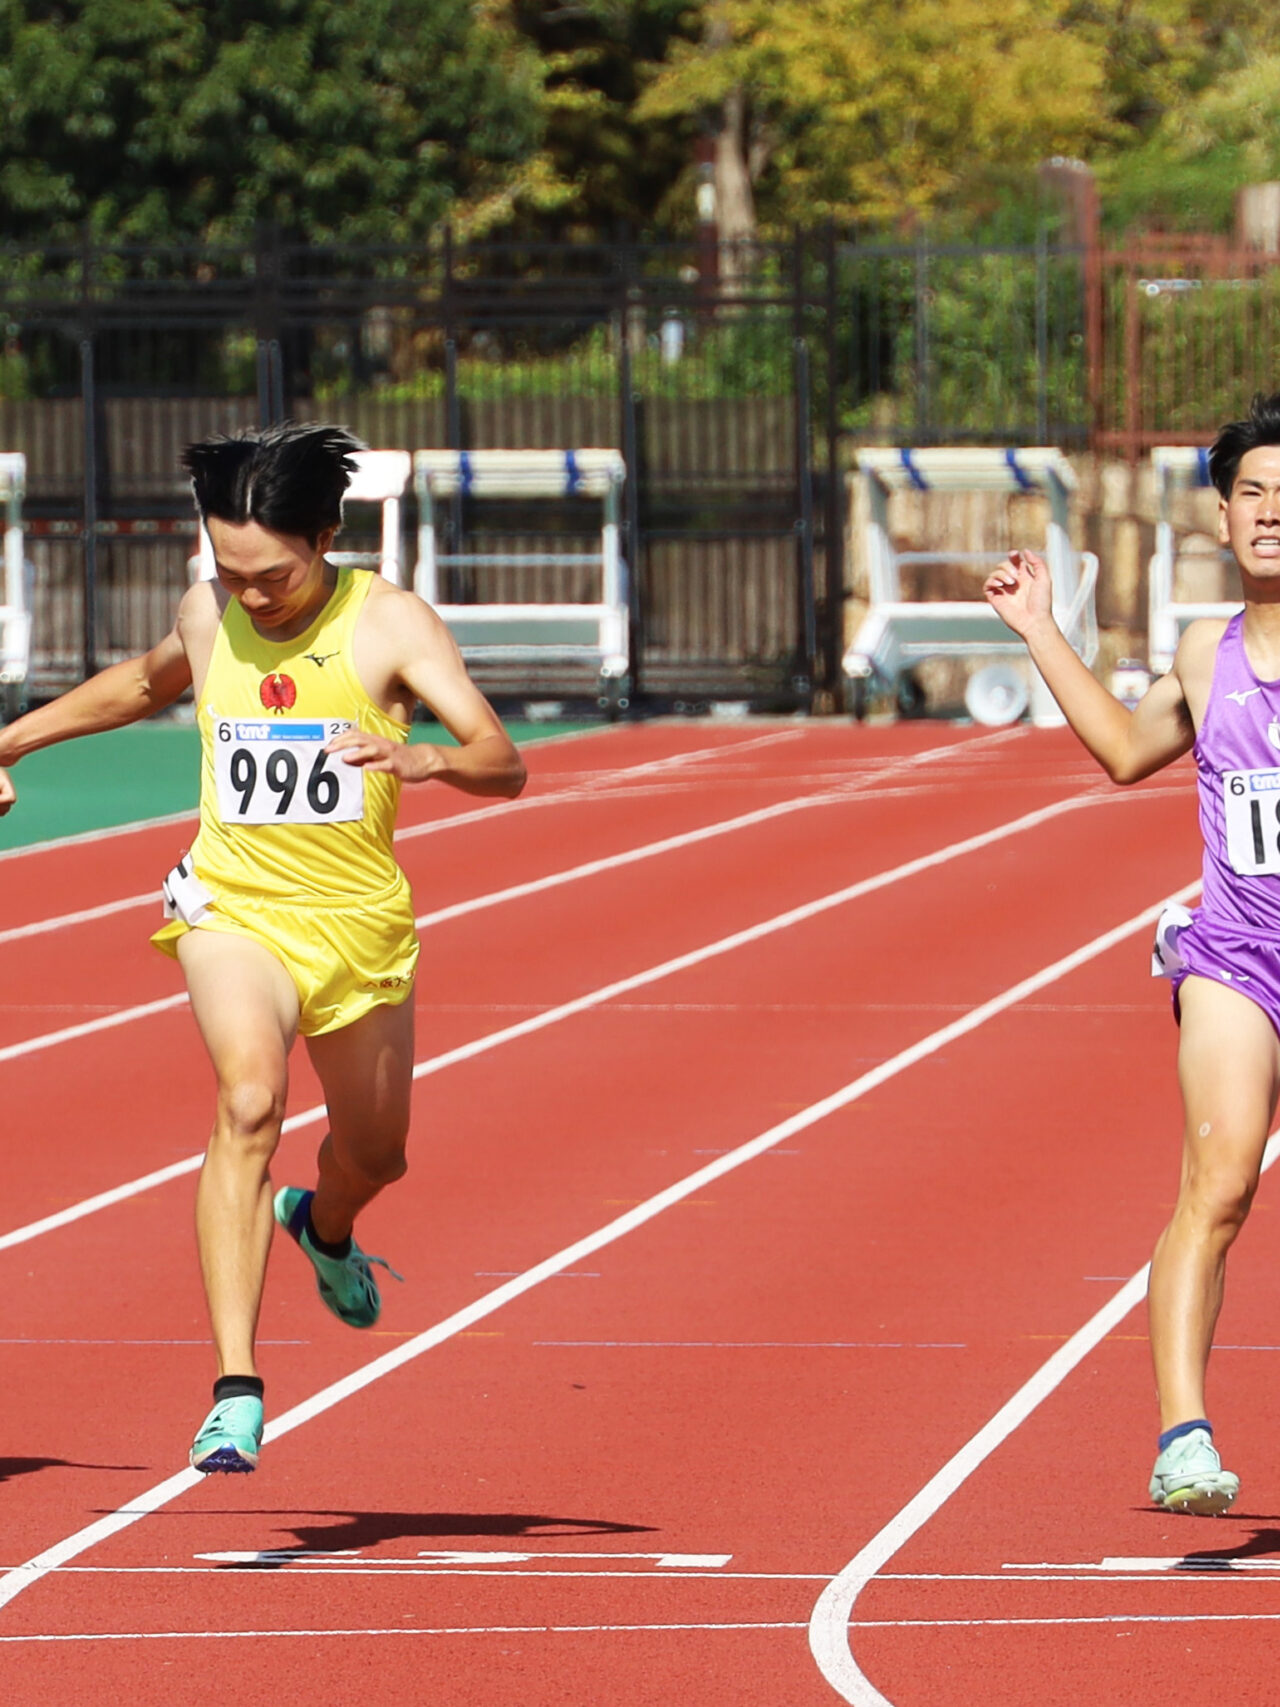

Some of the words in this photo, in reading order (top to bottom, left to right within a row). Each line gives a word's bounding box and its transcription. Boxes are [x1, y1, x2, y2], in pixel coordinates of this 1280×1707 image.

[218, 722, 232, 742] 6
[230, 747, 340, 815] 996
[1230, 776, 1245, 796] 6
